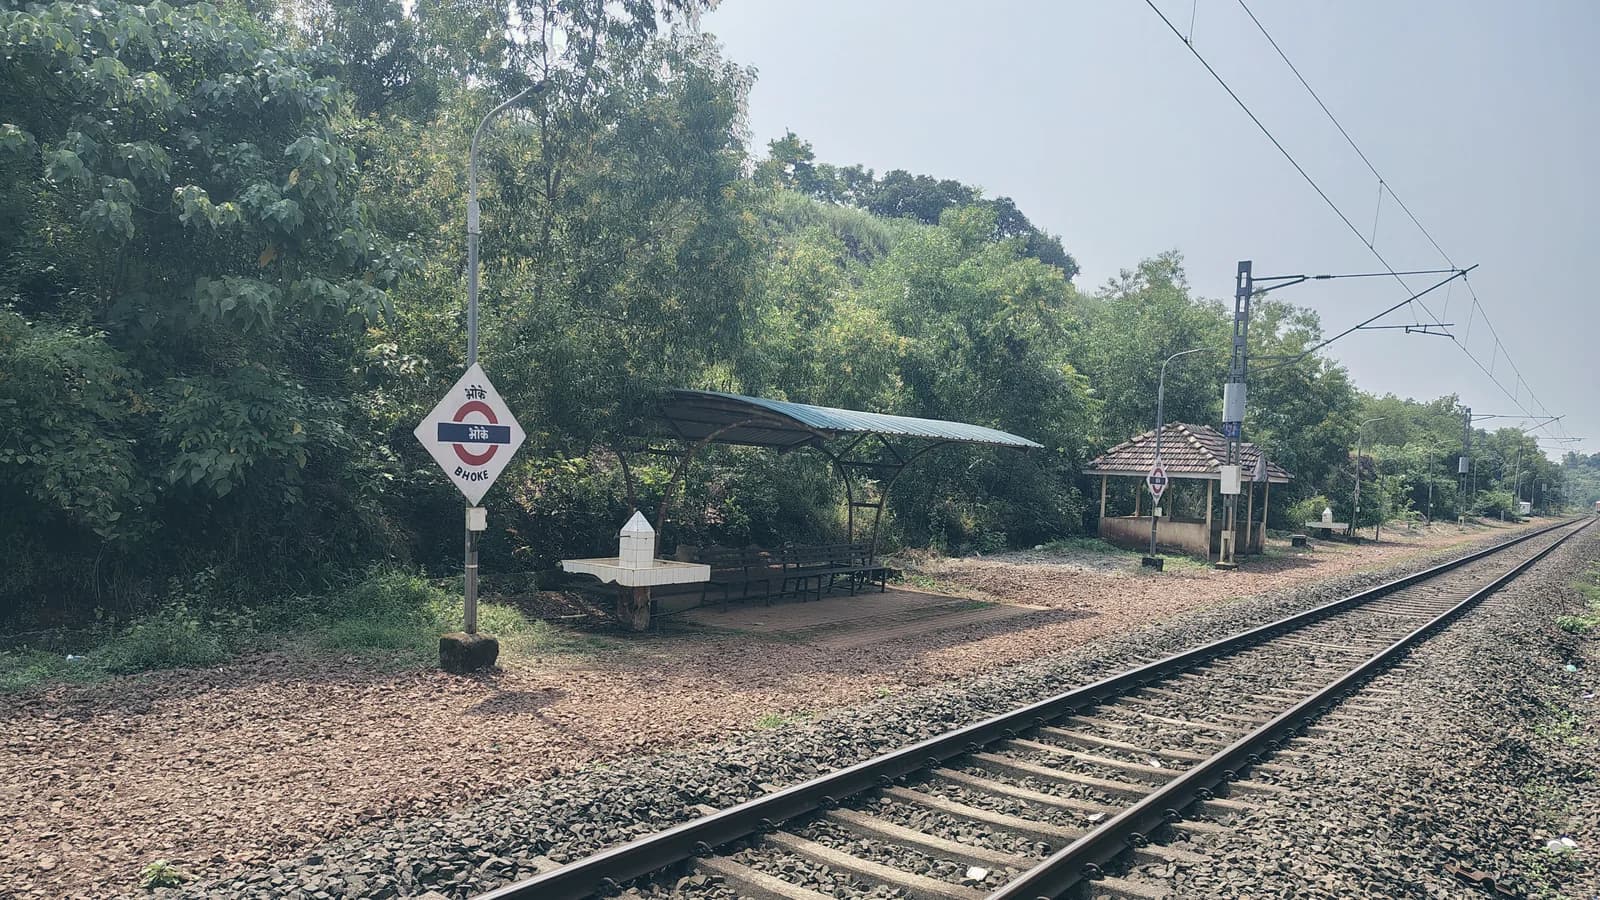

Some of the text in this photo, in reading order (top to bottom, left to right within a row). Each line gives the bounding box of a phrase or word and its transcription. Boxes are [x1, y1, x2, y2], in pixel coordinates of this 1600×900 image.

[464, 384, 487, 400] भोके
[468, 426, 489, 440] भोके
[454, 466, 489, 482] BHOKE
